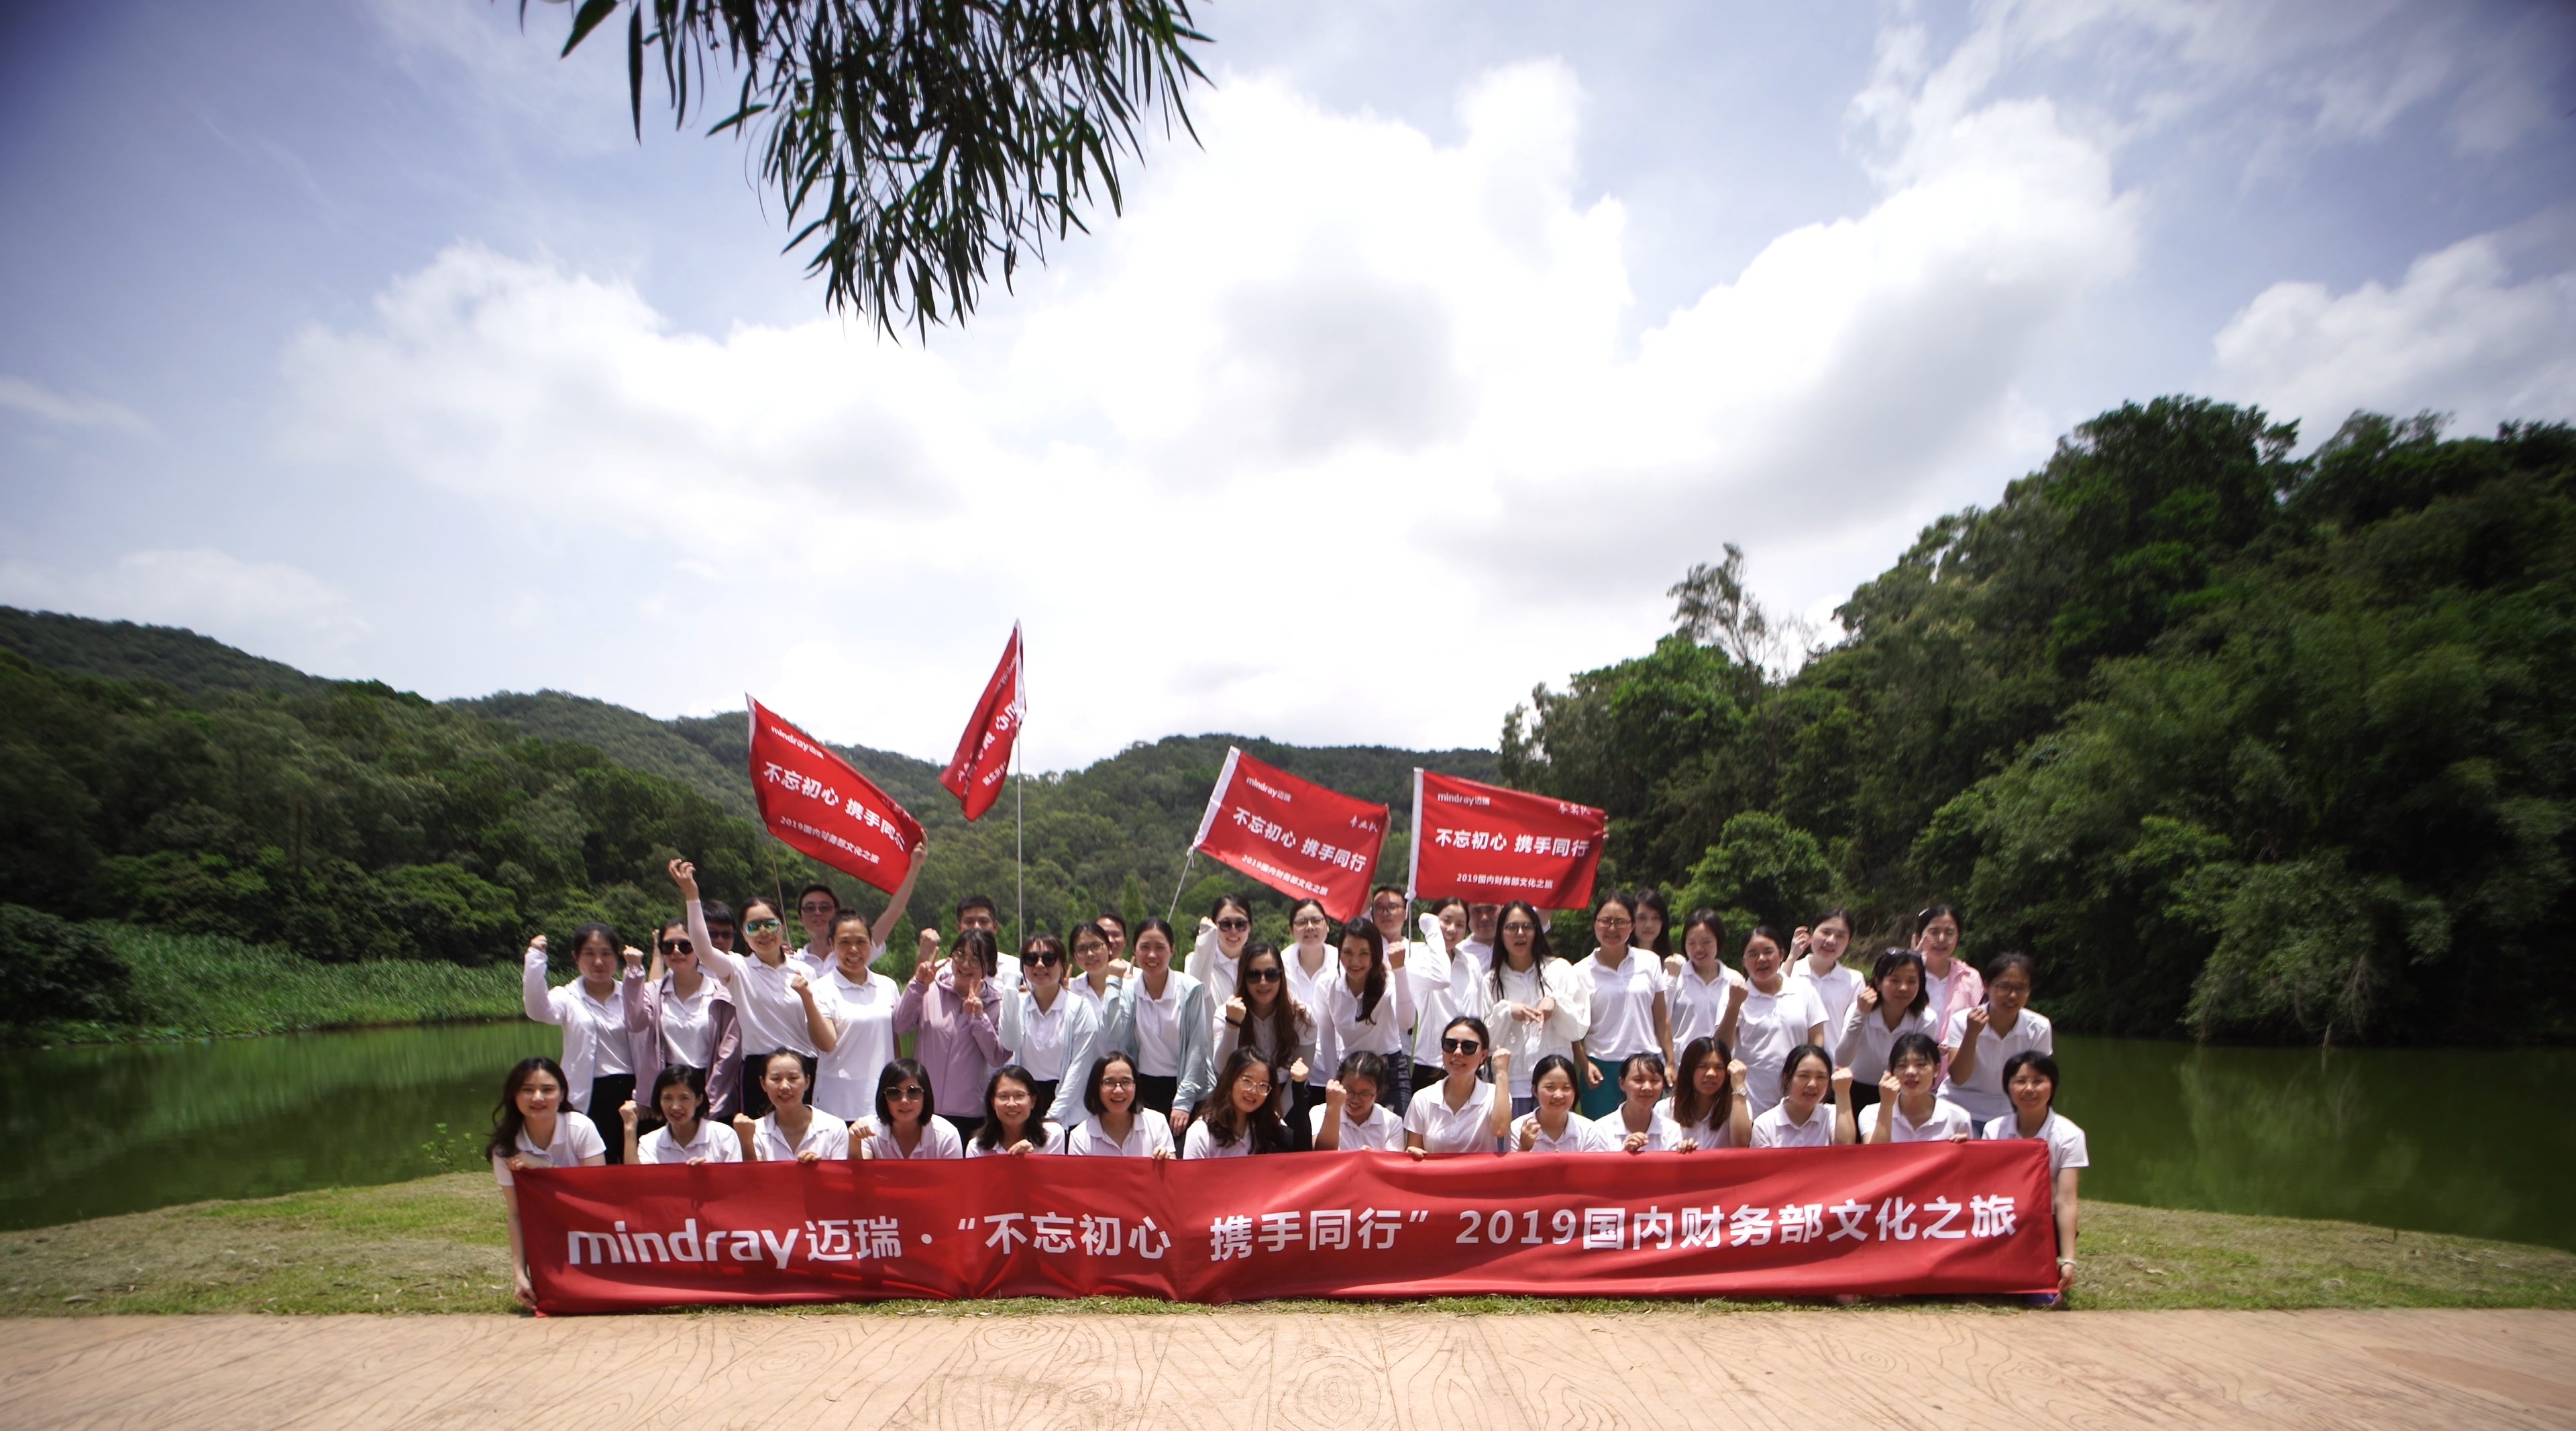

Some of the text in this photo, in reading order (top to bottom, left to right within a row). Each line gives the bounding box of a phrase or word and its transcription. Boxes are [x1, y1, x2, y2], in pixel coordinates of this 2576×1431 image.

[763, 761, 839, 806] 不忘初心
[1233, 806, 1367, 873] 不忘初心 携手同行
[1435, 828, 1590, 857] 不忘初心 携手同行
[1456, 1194, 2018, 1251] 2019国内财务部文化之旅
